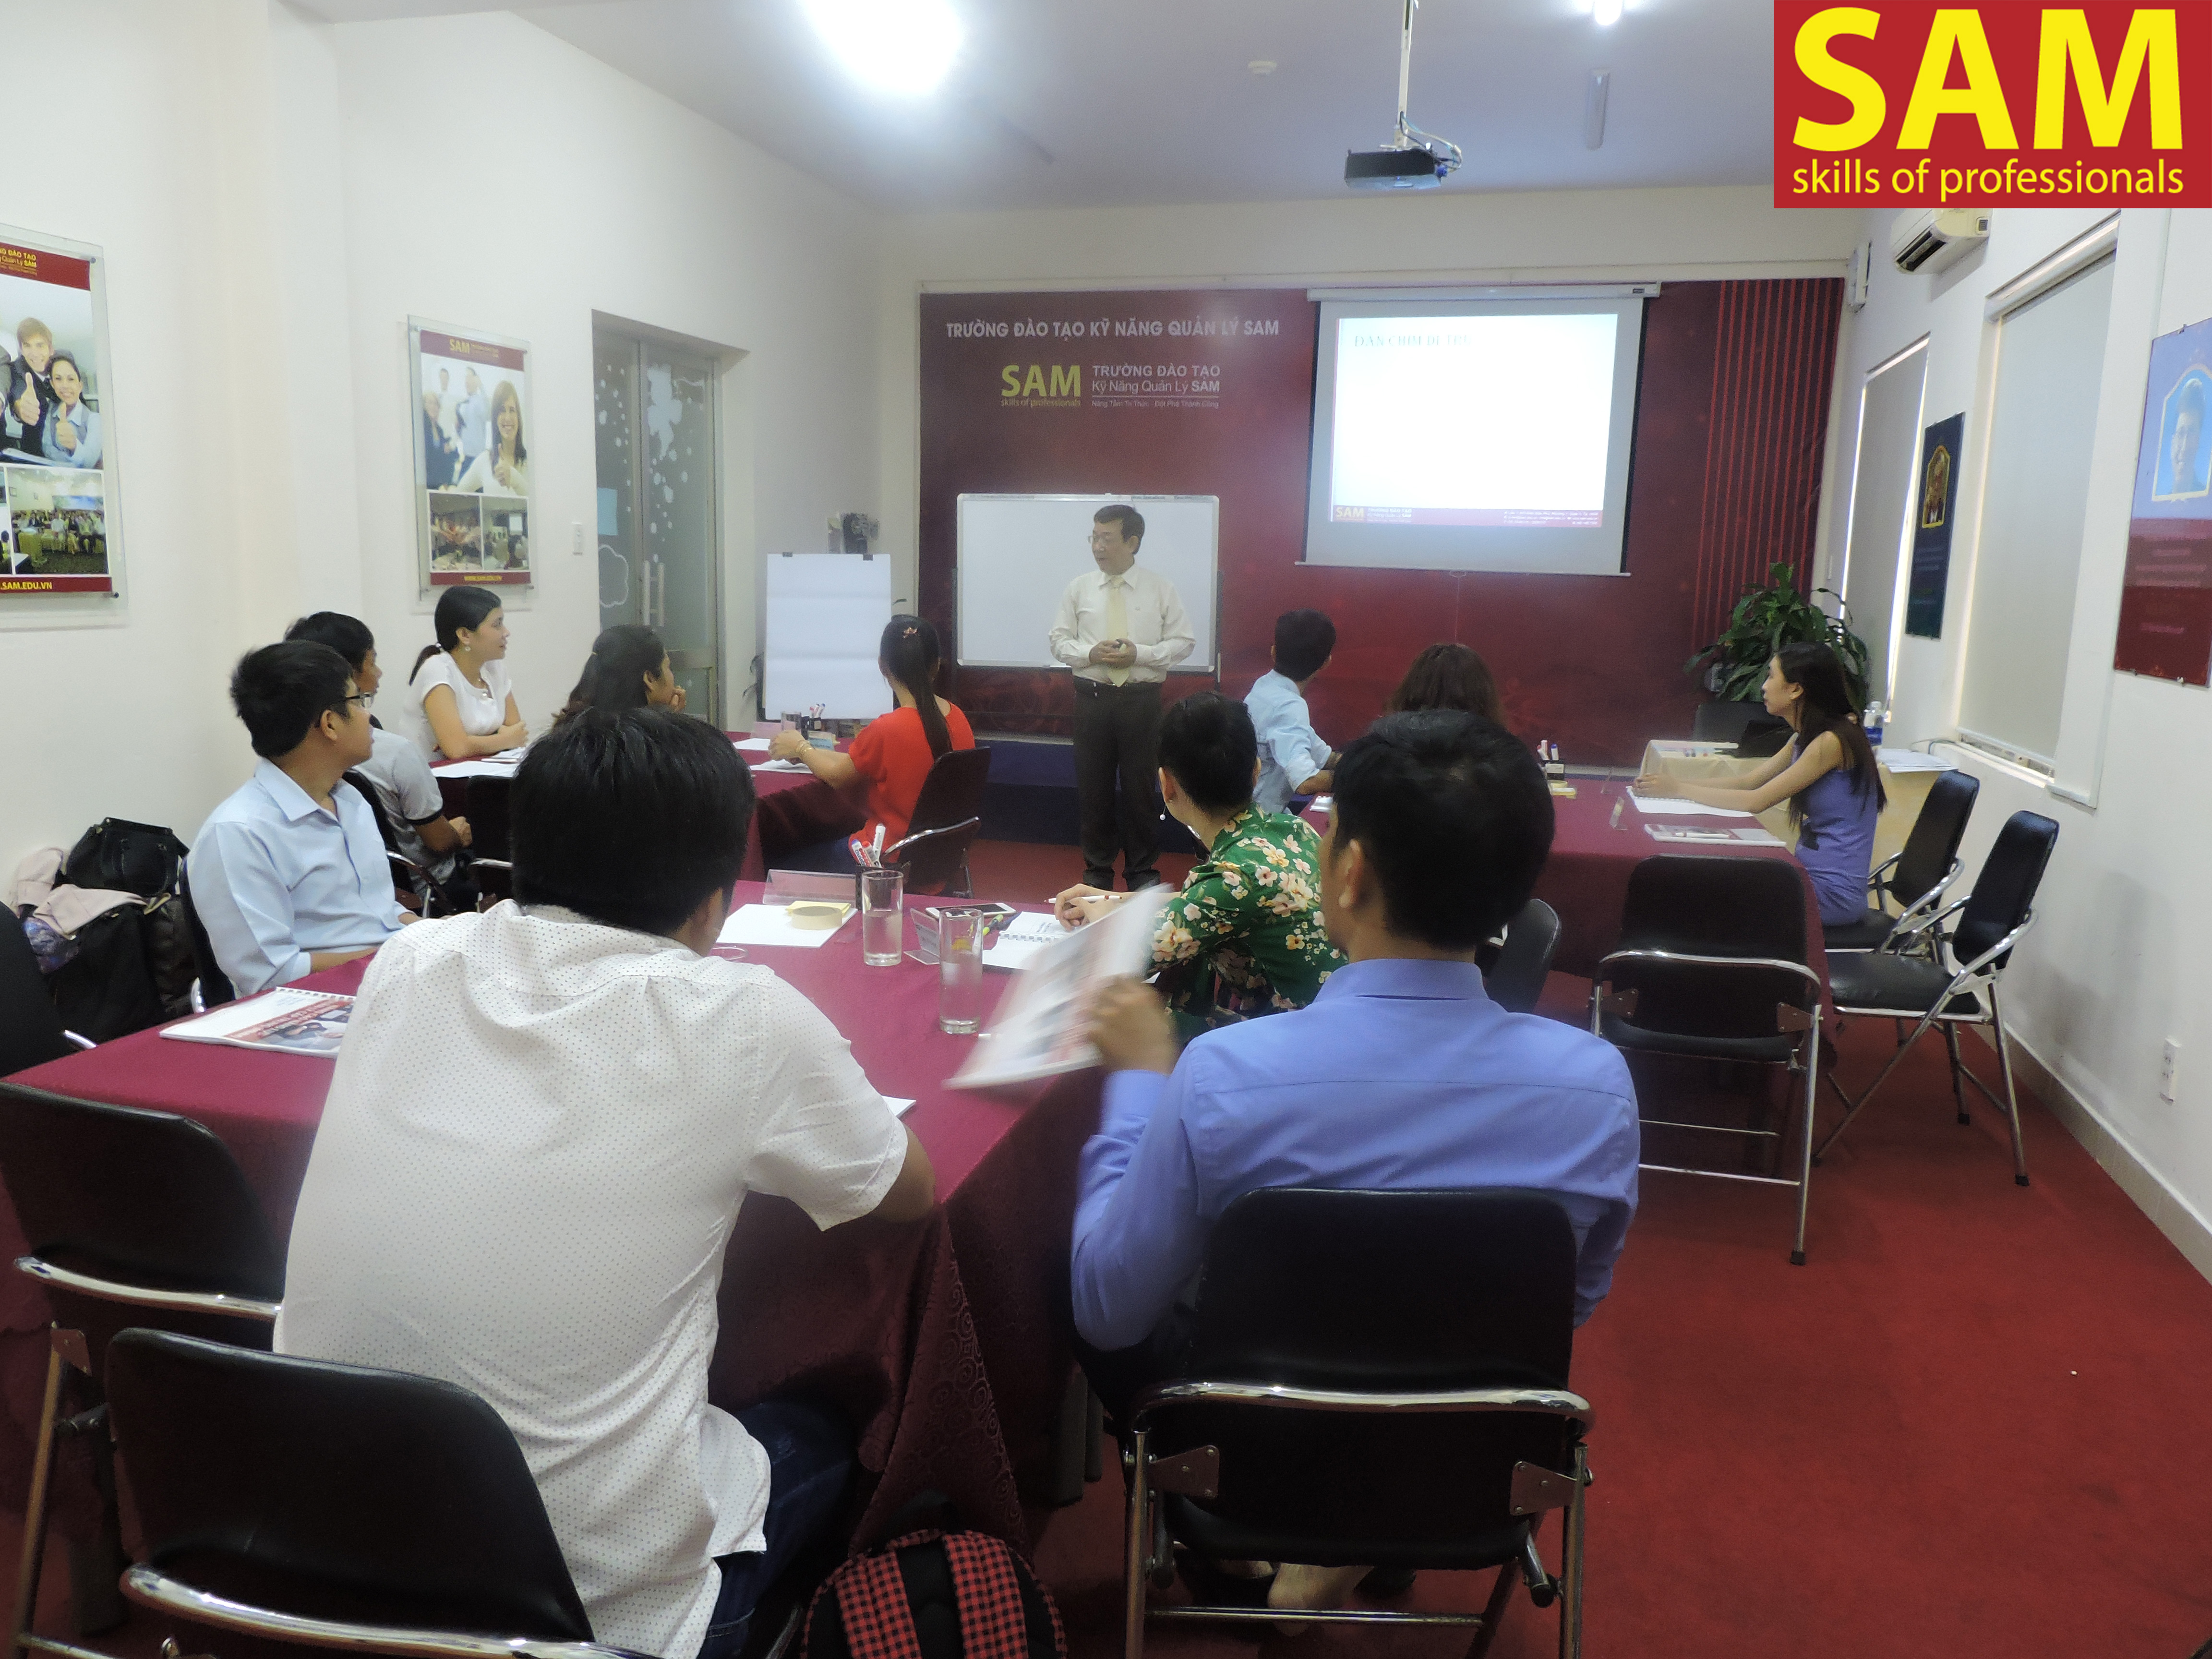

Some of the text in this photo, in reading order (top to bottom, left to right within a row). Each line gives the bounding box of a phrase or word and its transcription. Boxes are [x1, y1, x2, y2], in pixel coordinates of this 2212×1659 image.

[947, 315, 1279, 341] TRƯỜNG ĐÀO TẠO KỸ NĂNG QUẢN LÝ SAM
[449, 338, 470, 353] SAM
[1092, 362, 1220, 379] TRƯỜNG ĐÀO TẠO
[1001, 364, 1081, 397] SAM
[1092, 379, 1220, 395] Kỹ Năng Quản Lý SAM
[1336, 507, 1364, 518] SAM
